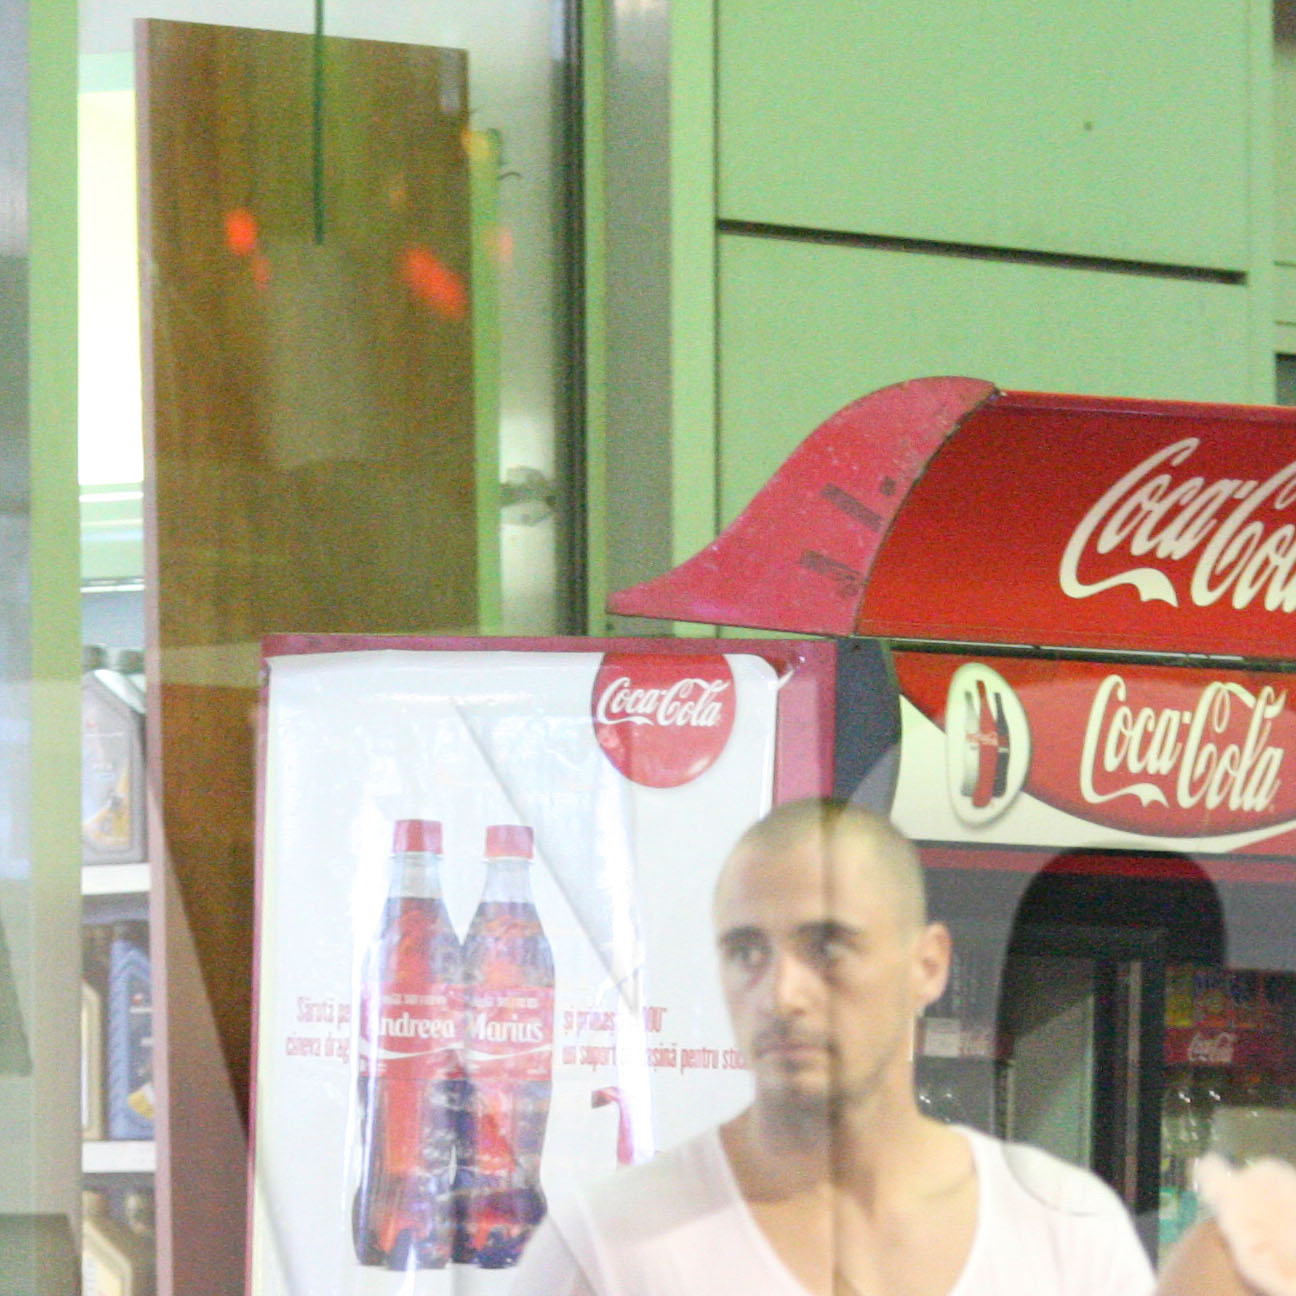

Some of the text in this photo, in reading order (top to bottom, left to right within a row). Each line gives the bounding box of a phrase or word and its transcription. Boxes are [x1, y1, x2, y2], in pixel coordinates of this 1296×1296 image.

[596, 675, 731, 729] Coca-Cola
[1079, 673, 1287, 813] Coca-Cola
[380, 1013, 454, 1038] ndreea
